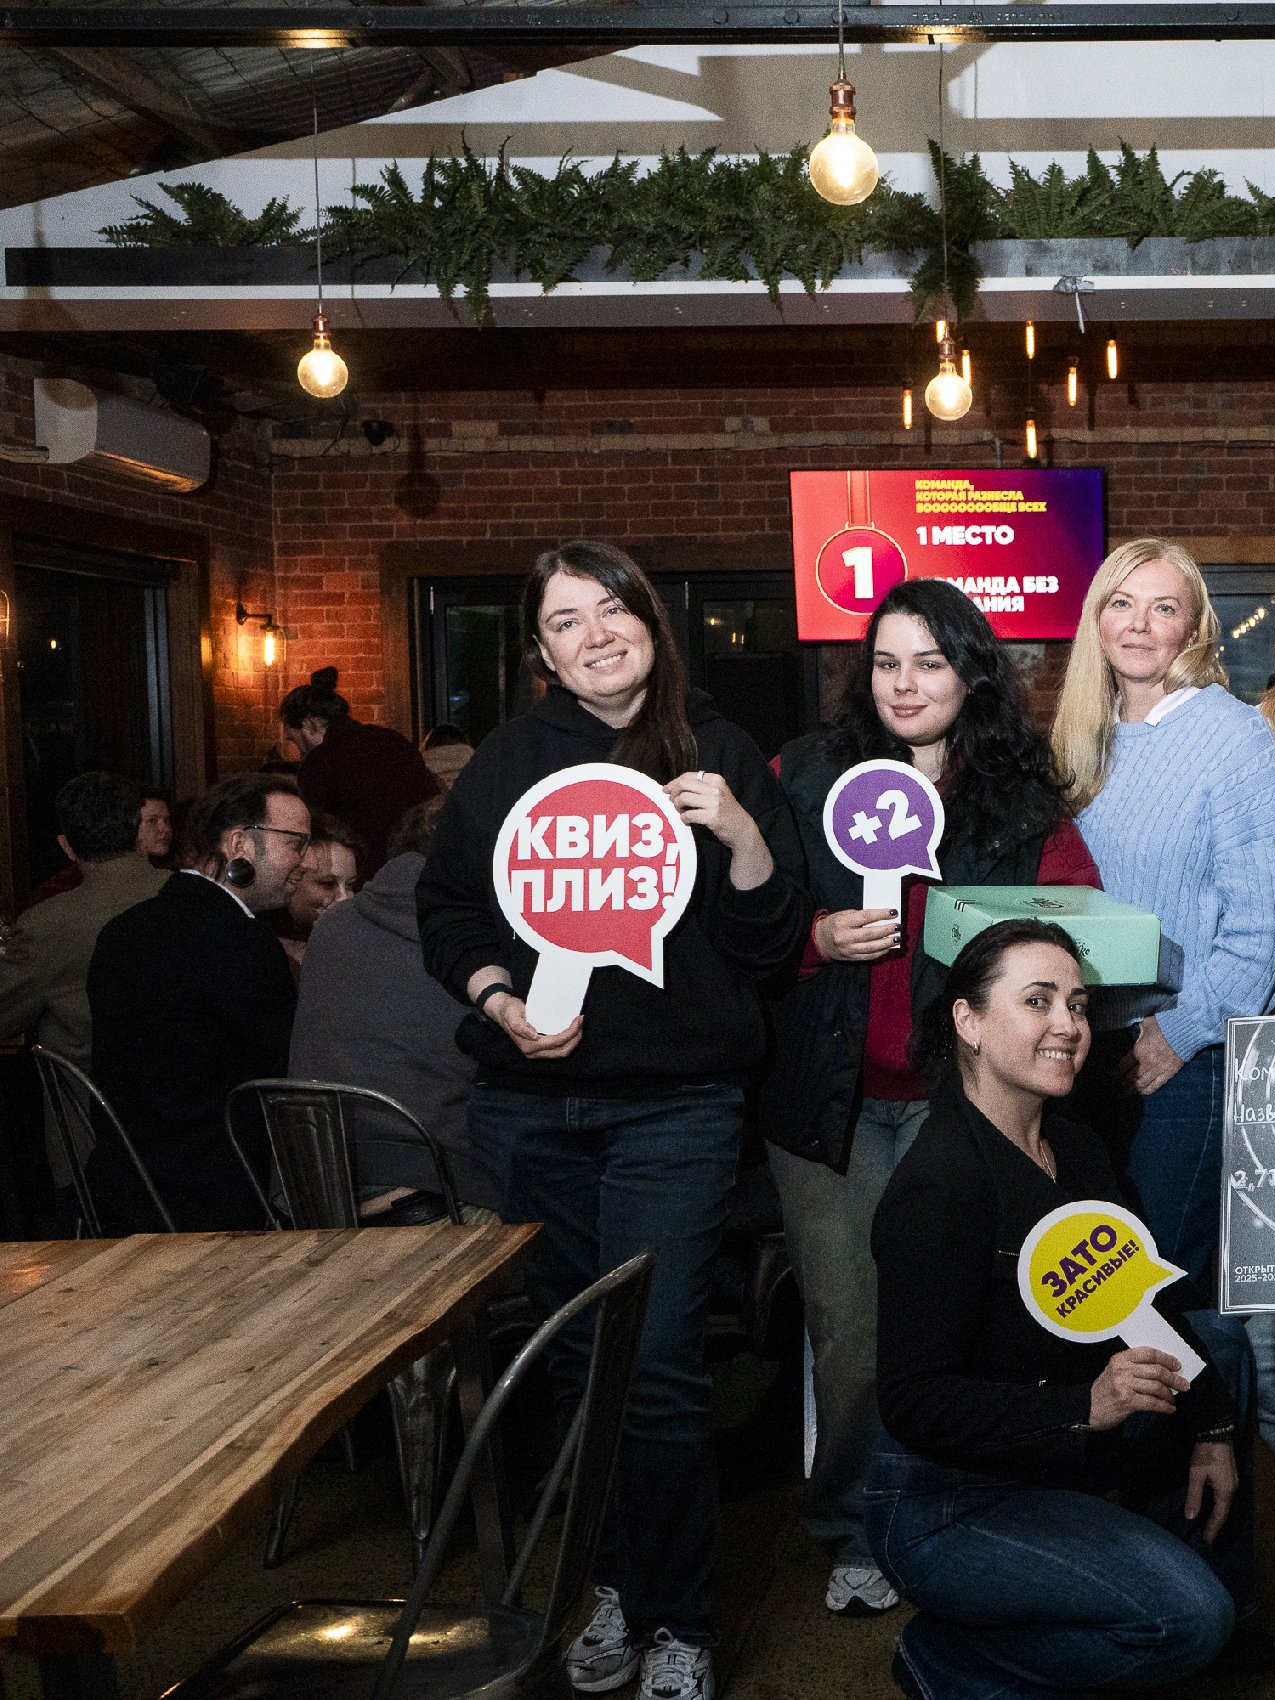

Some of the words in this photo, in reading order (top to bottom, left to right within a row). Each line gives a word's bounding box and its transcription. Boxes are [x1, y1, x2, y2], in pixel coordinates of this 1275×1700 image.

[915, 490, 967, 501] КОТОРАЯ
[968, 490, 1024, 501] РАЗНЕСЛА
[1018, 501, 1047, 512] ВСЕХ
[916, 526, 928, 545] 1
[932, 525, 1015, 545] МЕСТО
[842, 547, 874, 599] 1
[922, 576, 1020, 595] МАНДА
[1023, 576, 1059, 593] БЕЗ
[515, 813, 681, 863] КВИЗ,
[848, 789, 923, 845] +2
[511, 863, 677, 912] ПЛИЗ!
[1041, 1224, 1117, 1298] ЗАТО
[1055, 1239, 1140, 1318] КРАСИВЫЕ!
